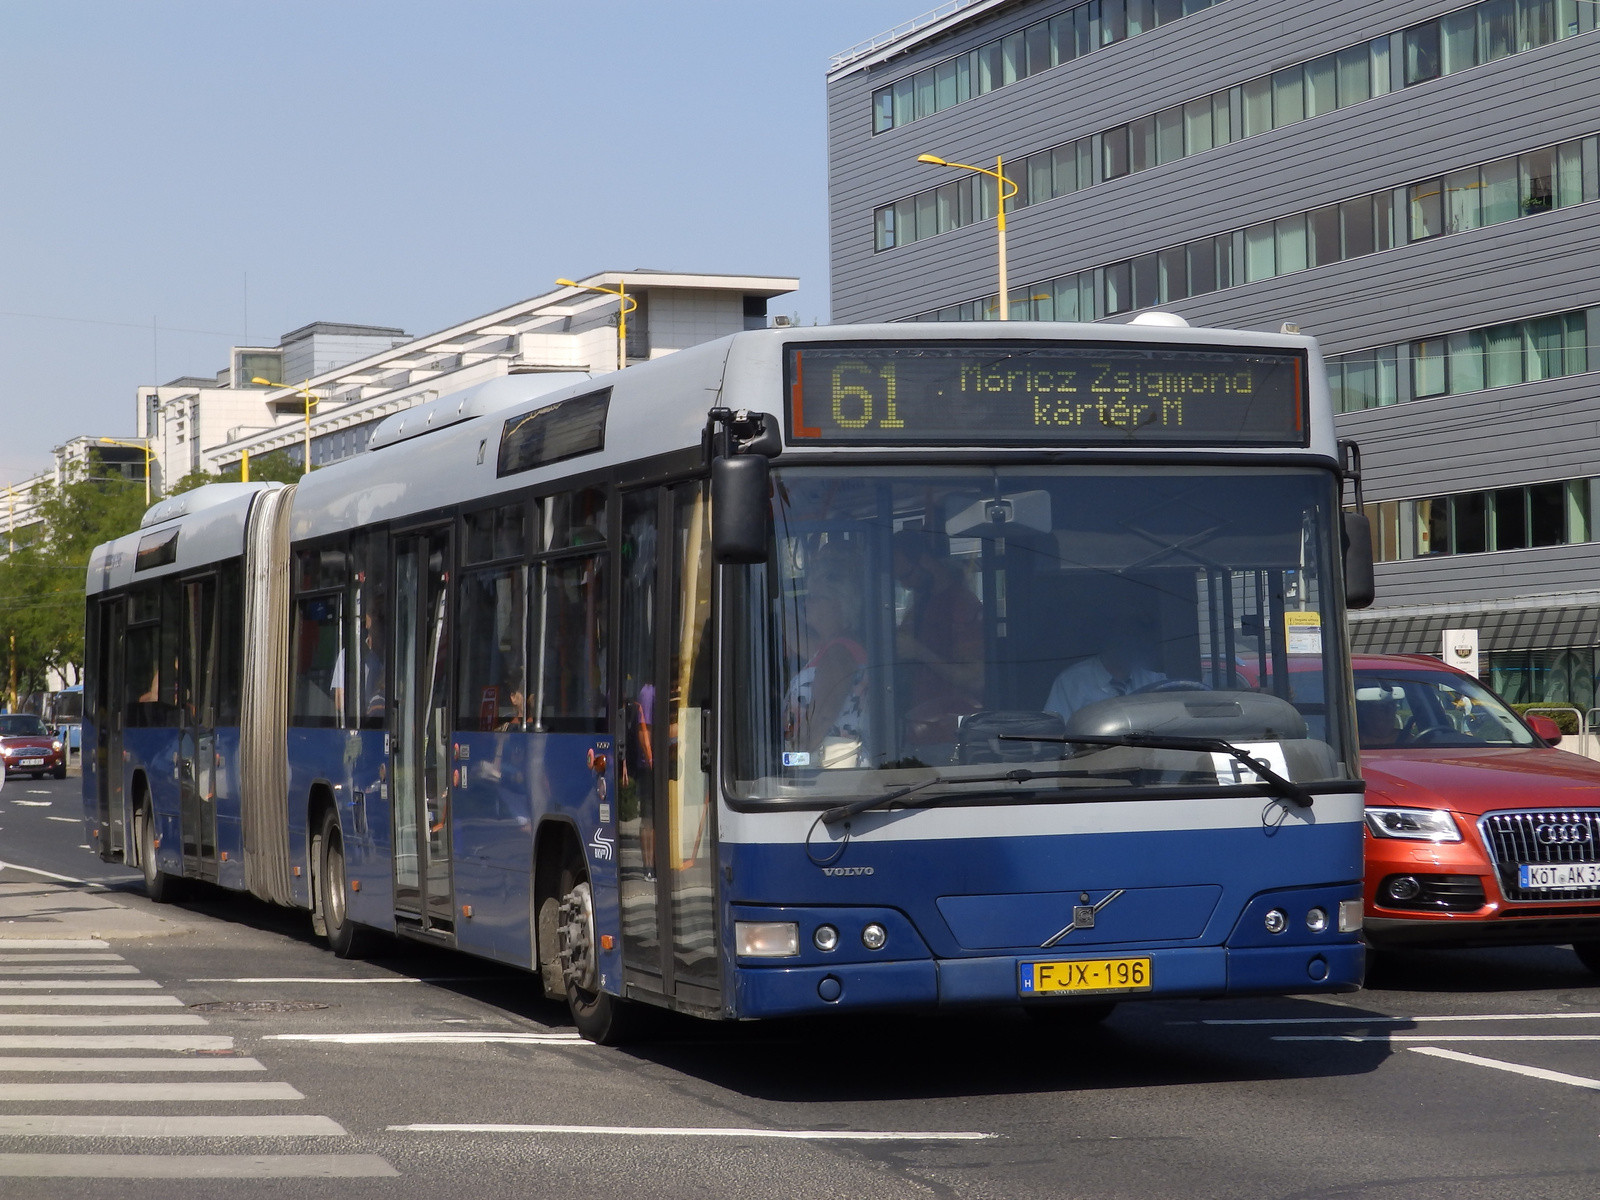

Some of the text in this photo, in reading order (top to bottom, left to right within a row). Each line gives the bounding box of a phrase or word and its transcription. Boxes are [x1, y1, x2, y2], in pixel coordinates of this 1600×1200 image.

[961, 363, 1252, 397] Móricz Zsigmond
[832, 361, 904, 428] 61
[1035, 396, 1183, 425] körtér M
[822, 866, 875, 877] VOLVO
[1568, 867, 1585, 883] AK
[1024, 979, 1031, 988] H
[1039, 962, 1144, 988] FJX-196
